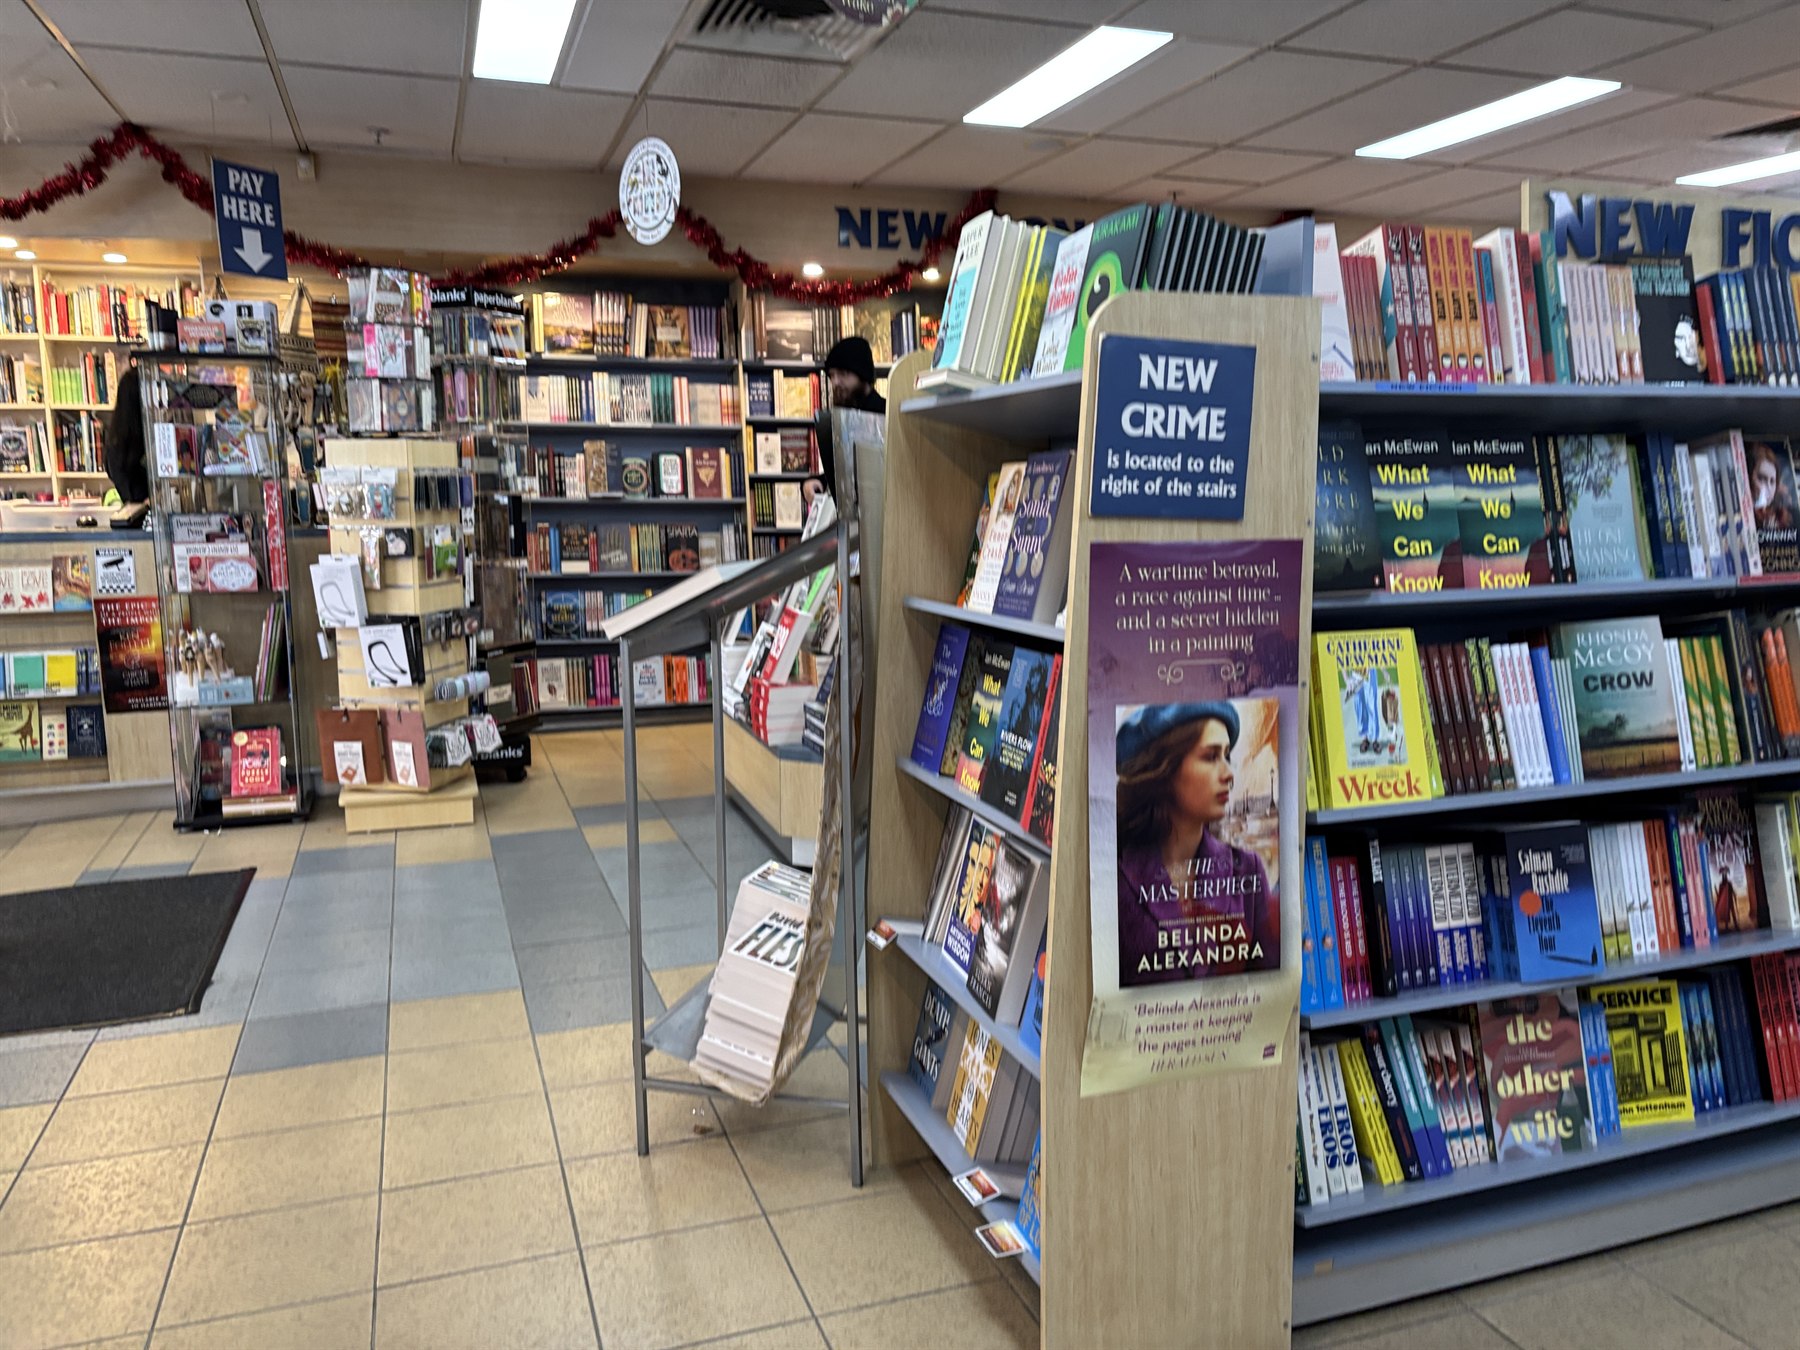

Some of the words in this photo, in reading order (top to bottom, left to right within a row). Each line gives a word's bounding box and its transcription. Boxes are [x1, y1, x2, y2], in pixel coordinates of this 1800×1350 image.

[227, 167, 264, 198] PAY
[222, 193, 276, 228] HERE
[835, 206, 948, 249] NEW
[1093, 211, 1139, 243] URAKAMI
[1546, 190, 1695, 258] NEW
[430, 288, 468, 304] blanks
[1138, 353, 1219, 394] NEW
[1121, 401, 1227, 443] CRIME
[1318, 444, 1344, 463] LD
[1365, 441, 1381, 456] an
[1384, 438, 1439, 456] McEwan
[1451, 441, 1471, 456] Ian
[1473, 439, 1525, 455] McEwan
[1107, 448, 1120, 469] is
[1125, 450, 1182, 472] located
[1187, 456, 1205, 473] to
[1210, 454, 1235, 475] the
[1466, 462, 1516, 485] What
[1101, 473, 1140, 498] right
[1144, 476, 1163, 496] of
[1167, 477, 1192, 497] the
[1197, 478, 1237, 500] stairs
[1322, 467, 1349, 486] RK
[1377, 463, 1430, 486] What
[1019, 495, 1051, 519] Sonia
[1316, 491, 1360, 511] ORE
[1391, 500, 1425, 521] We
[1481, 499, 1511, 520] We
[1011, 526, 1044, 559] Sunny
[1393, 536, 1433, 558] Can
[1482, 534, 1520, 555] Can
[1119, 562, 1132, 583] A
[1138, 561, 1208, 582] wartime
[1389, 572, 1444, 594] Know
[1479, 570, 1530, 591] Know
[1115, 592, 1126, 607] a
[1132, 589, 1169, 606] race
[1173, 586, 1233, 609] against
[1237, 584, 1271, 603] time
[1116, 610, 1151, 632] and
[1155, 615, 1166, 629] a
[1171, 610, 1220, 629] secret
[1225, 605, 1280, 627] hidden
[1149, 636, 1165, 654] in
[1170, 639, 1180, 652] a
[1186, 632, 1254, 658] painting
[1326, 637, 1404, 656] CATHERINE
[1576, 628, 1650, 648] RHONDA
[992, 653, 1011, 671] McEwan
[1336, 651, 1398, 669] NEWMAN
[1574, 641, 1654, 669] McCOY
[983, 673, 1001, 697] What
[1583, 669, 1654, 693] CROW
[978, 706, 990, 728] We
[970, 736, 984, 760] Can
[1001, 729, 1018, 747] RIVERS
[1017, 734, 1033, 752] FLOW
[960, 766, 981, 793] Know
[1338, 768, 1423, 804] Wreck
[1711, 829, 1753, 851] RANT
[1187, 857, 1214, 876] THE
[1518, 848, 1554, 875] Salman
[1138, 874, 1262, 904] MASTERPIECE
[1531, 867, 1569, 896] Rushdie
[768, 911, 804, 930] David
[1527, 911, 1561, 935] Eleventh
[734, 923, 805, 972] FLES
[1158, 922, 1246, 949] BELINDA
[1538, 935, 1556, 956] Hour
[947, 934, 970, 967] WISDOM
[1137, 941, 1264, 974] ALEXANDRA
[1188, 992, 1249, 1012] Alexandra
[1252, 990, 1261, 1004] is
[1597, 986, 1673, 1010] SERVICE
[1135, 1026, 1142, 1036] a
[1146, 1022, 1188, 1035] master
[1192, 1018, 1204, 1030] at
[1208, 1011, 1253, 1028] keeping
[1506, 1013, 1553, 1046] the
[1138, 1040, 1158, 1054] the
[1162, 1038, 1196, 1055] pages
[913, 1036, 940, 1083] GIANTS
[1497, 1063, 1575, 1099] other
[1618, 1105, 1634, 1116] ohn
[1636, 1100, 1686, 1114] Tottenham
[1318, 1106, 1340, 1170] EROS
[1334, 1103, 1357, 1167] EROS
[1510, 1108, 1574, 1145] wife
